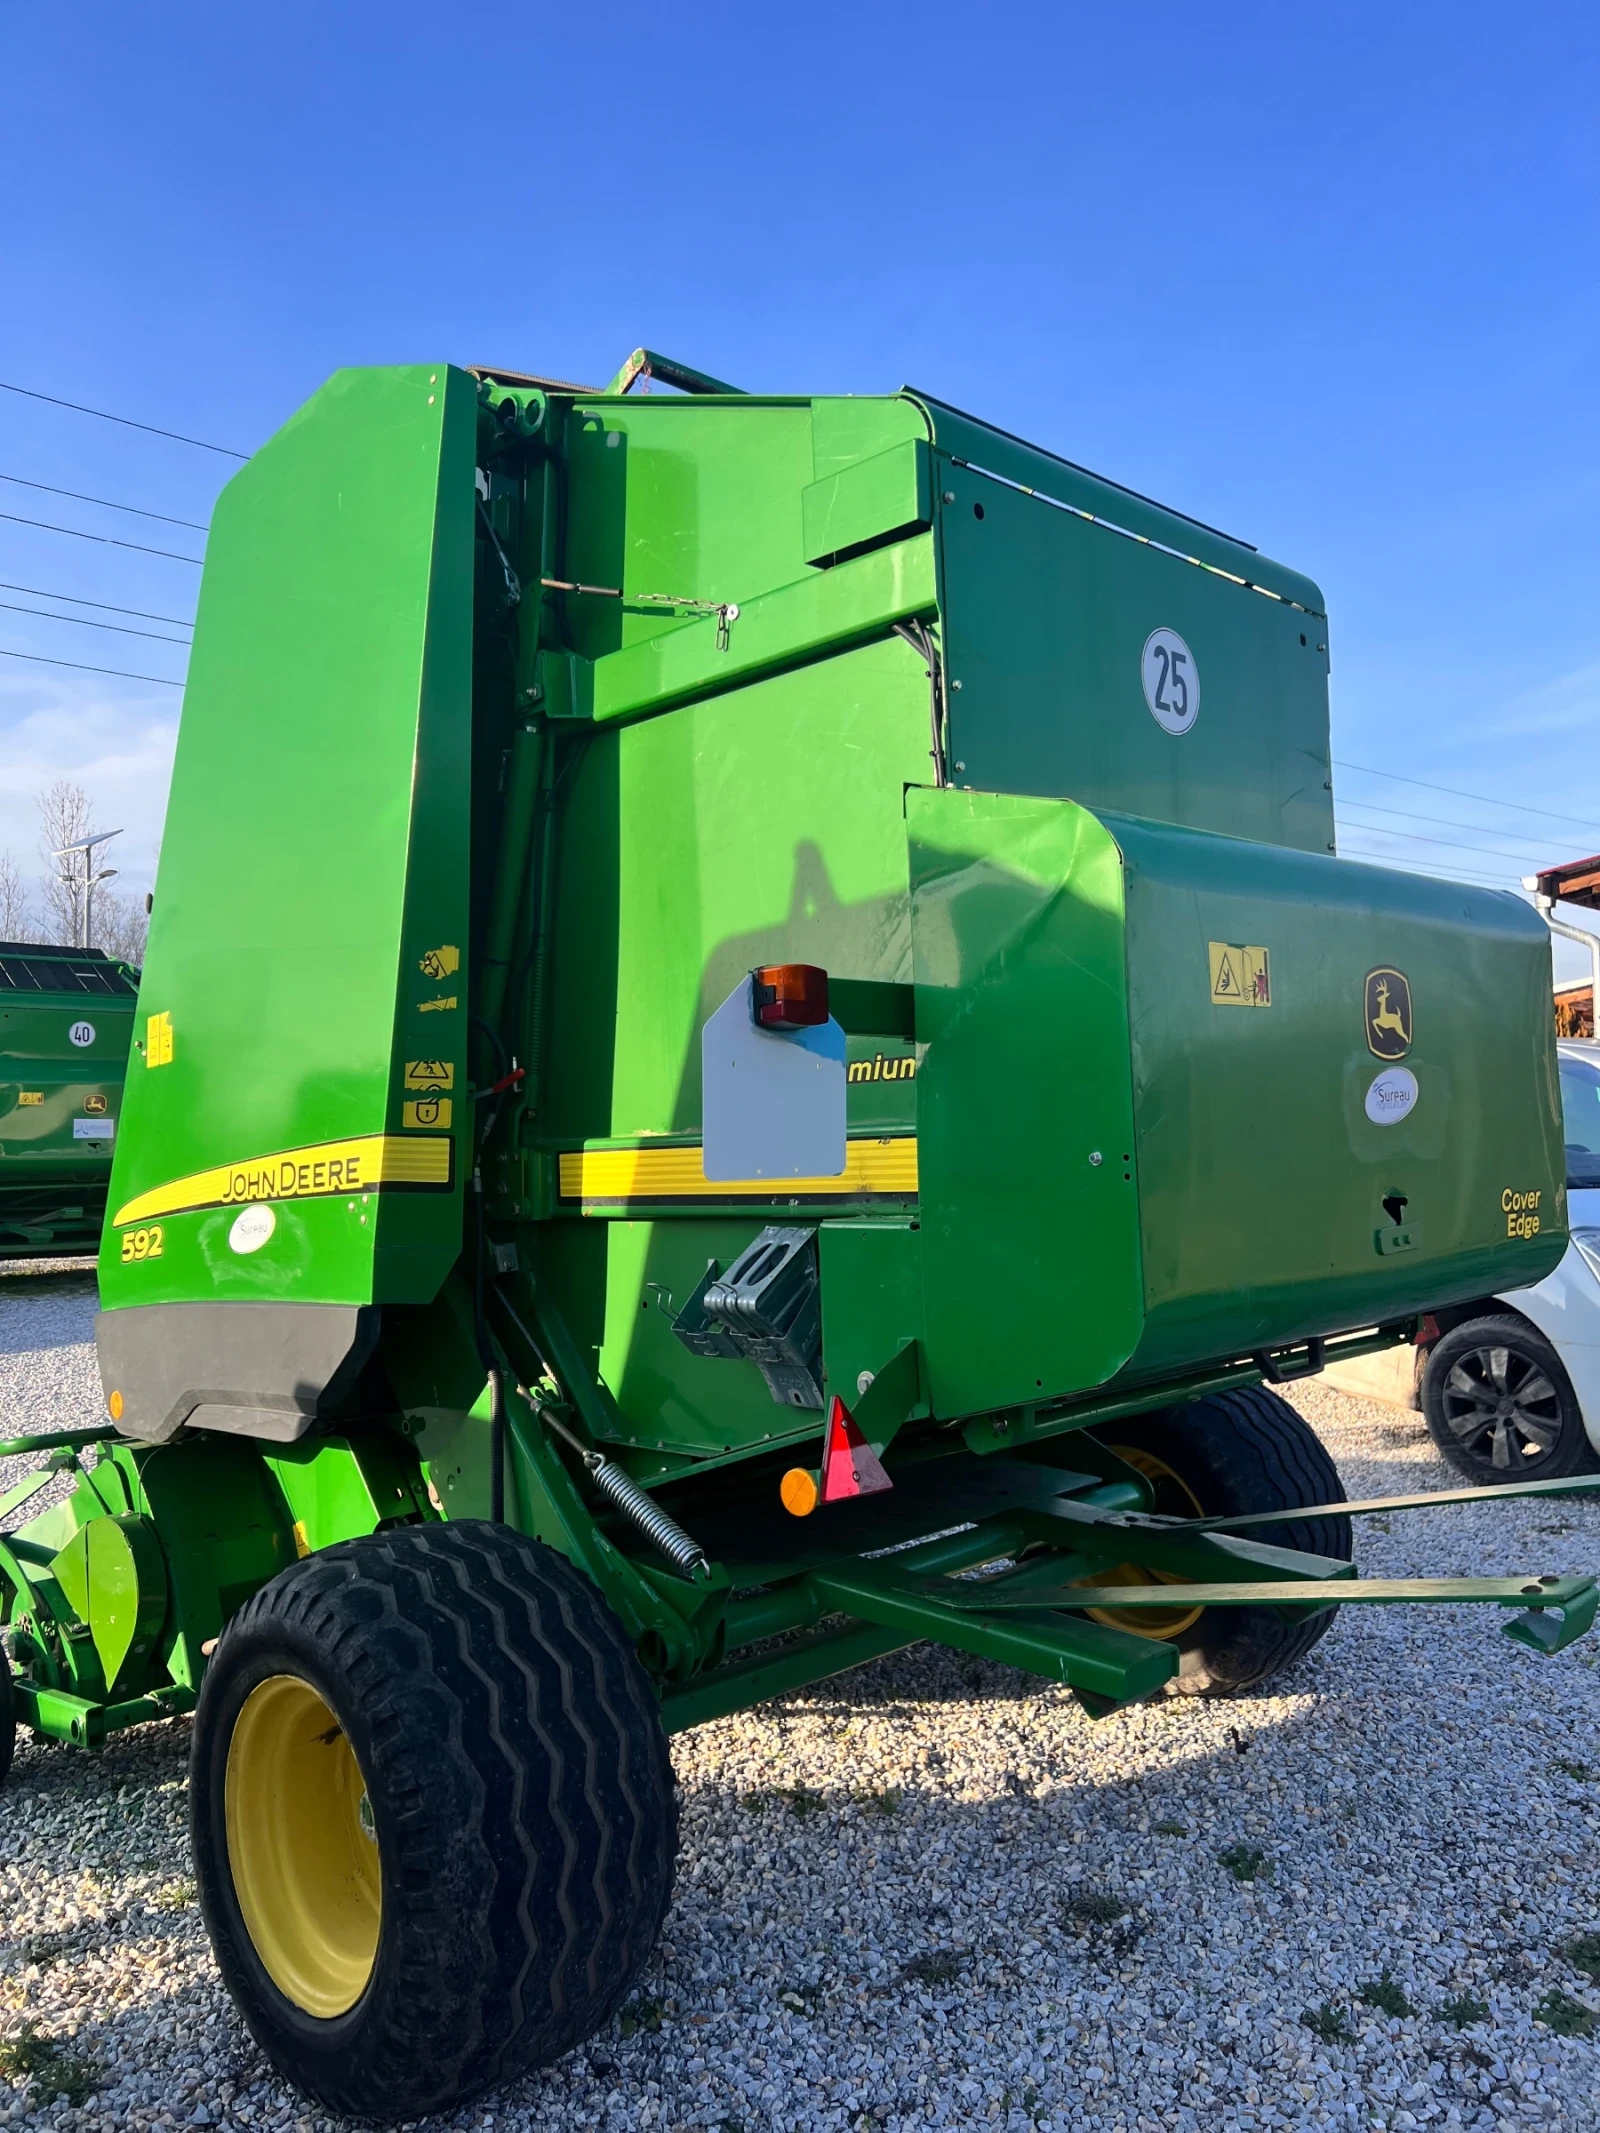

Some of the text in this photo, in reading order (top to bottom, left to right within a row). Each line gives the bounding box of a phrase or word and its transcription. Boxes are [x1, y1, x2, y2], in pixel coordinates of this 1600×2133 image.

[1153, 645, 1187, 717] 25
[74, 1026, 90, 1042] 40
[1378, 1088, 1410, 1103] Sureau
[222, 1157, 361, 1199] JOHN DEERE
[1501, 1187, 1541, 1212] Cover
[240, 1224, 268, 1236] Sureau
[1507, 1212, 1540, 1240] Edge
[121, 1224, 163, 1263] 592
